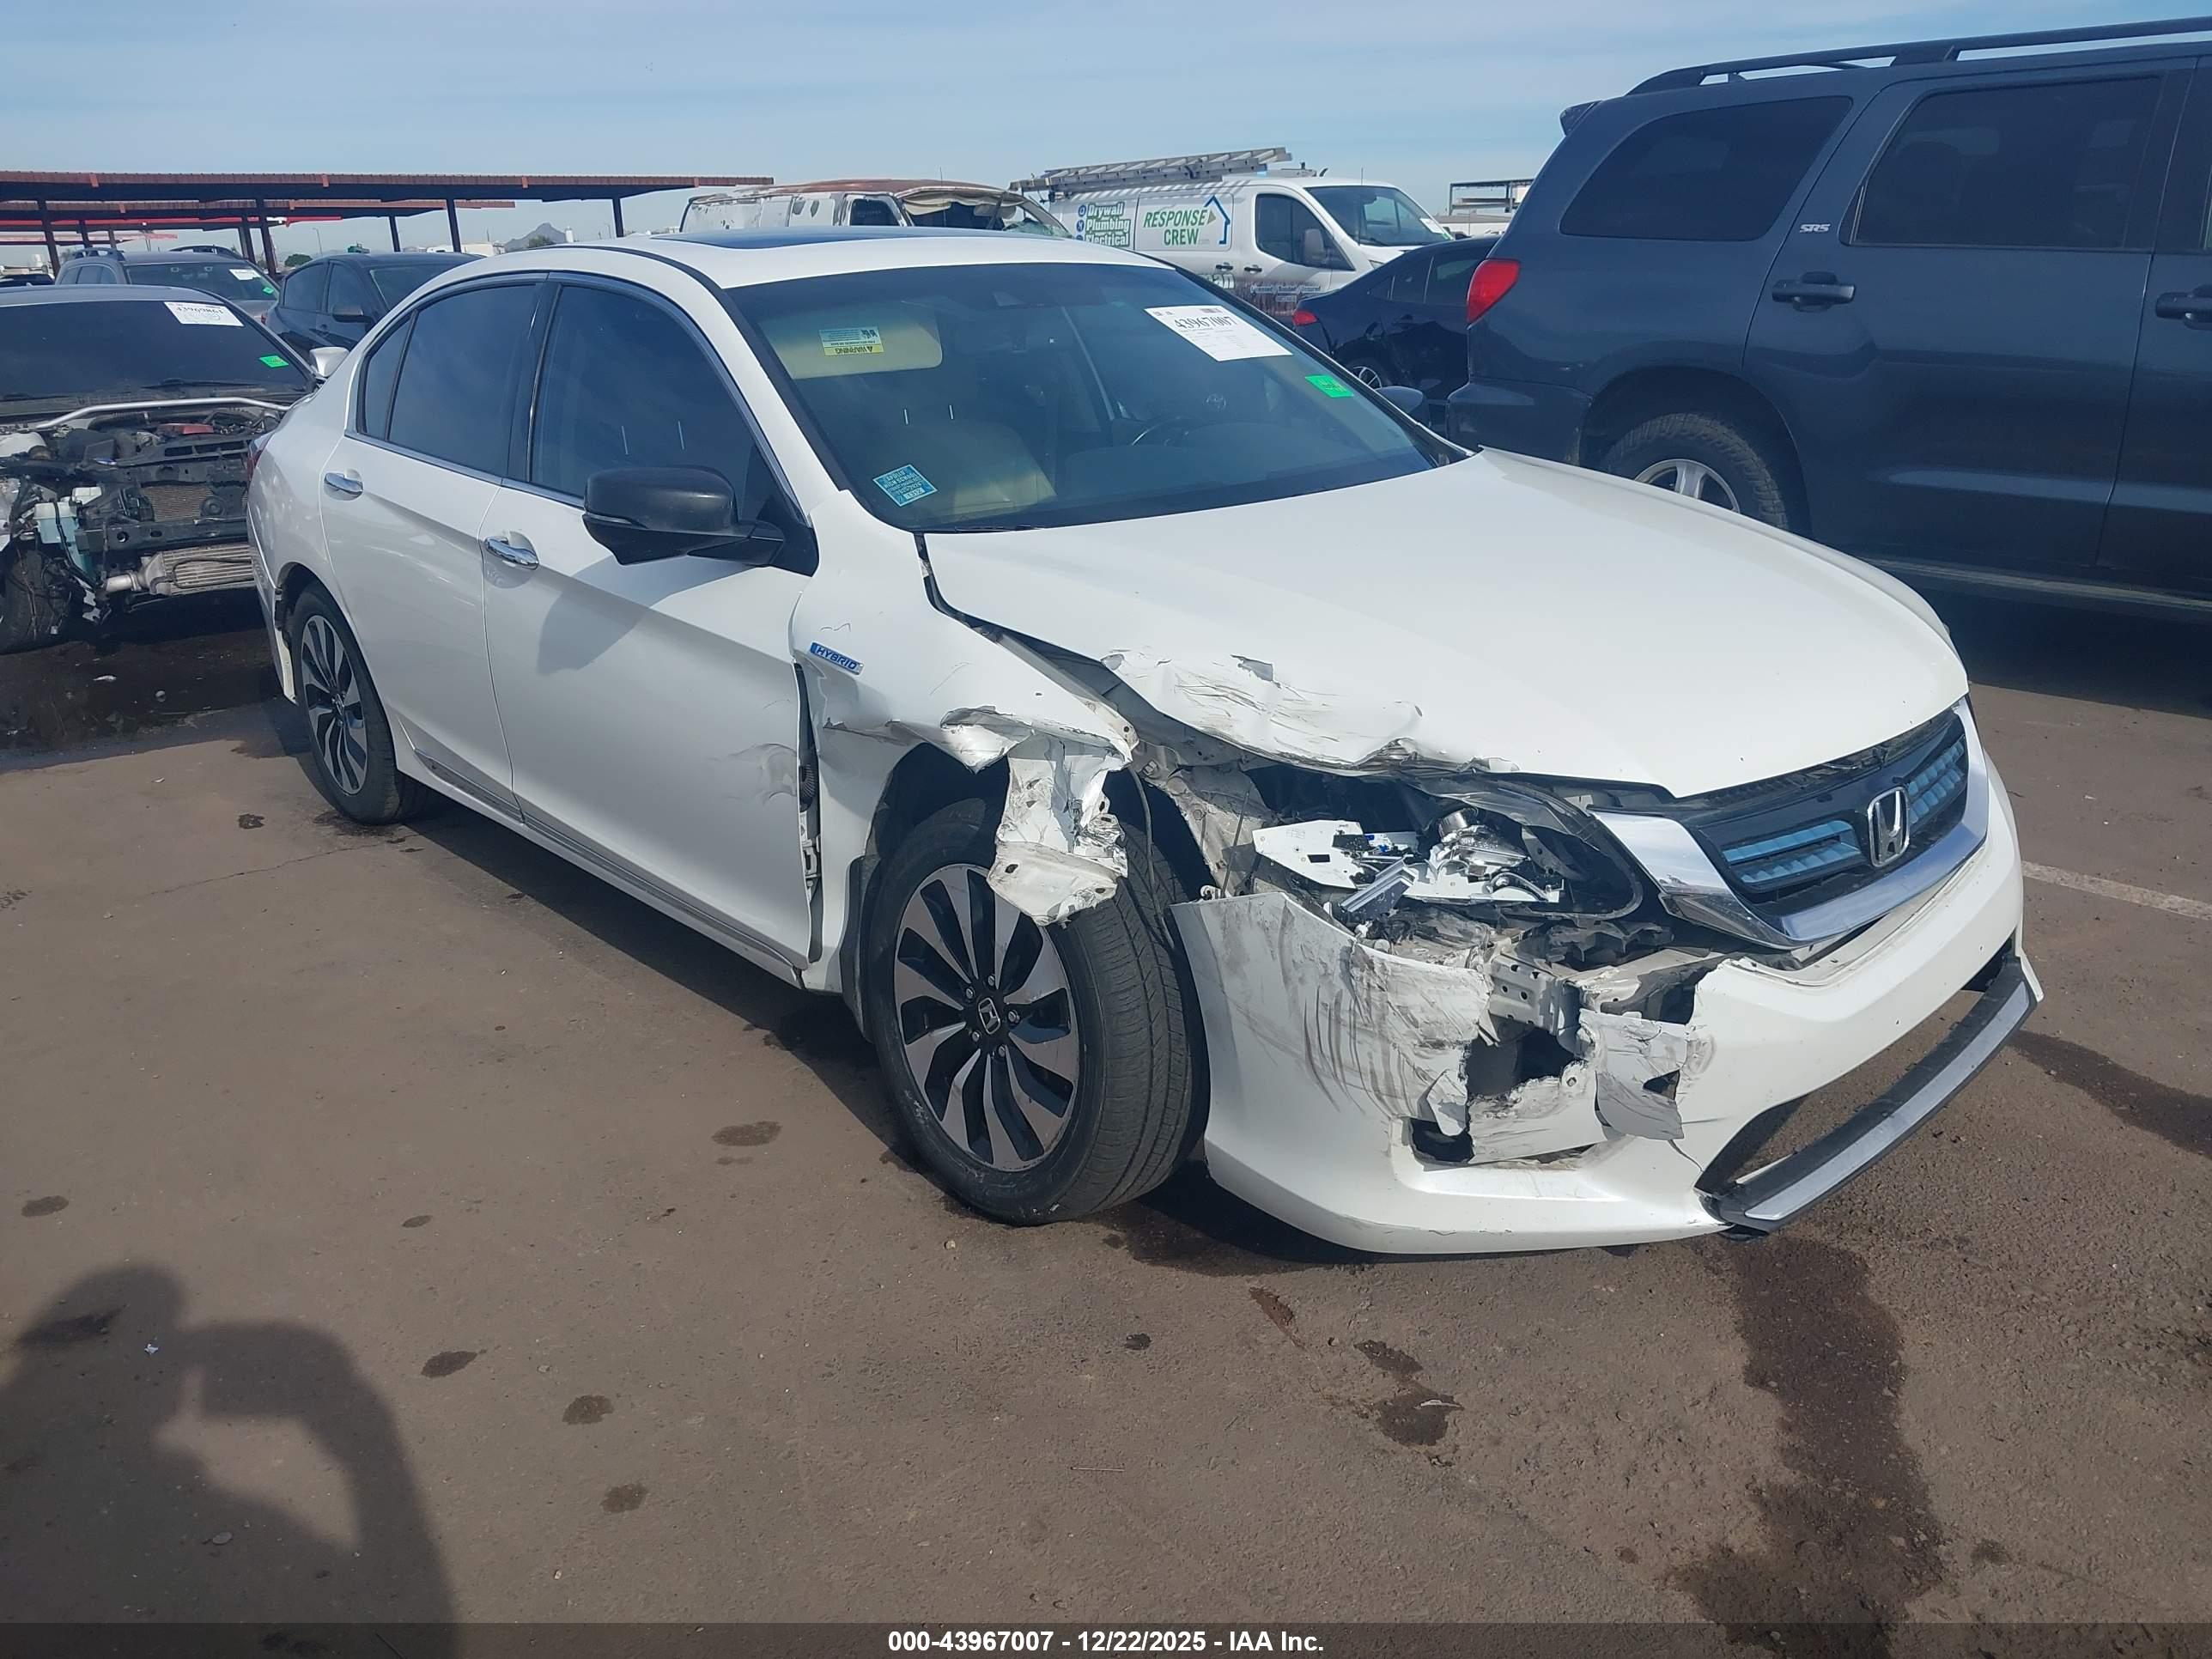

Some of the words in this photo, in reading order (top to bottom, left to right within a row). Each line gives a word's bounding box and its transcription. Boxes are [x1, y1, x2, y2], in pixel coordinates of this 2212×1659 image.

[1087, 202, 1124, 219] Drywall
[1143, 210, 1207, 228] RESPONSE
[1085, 218, 1130, 233] Plumbing
[1164, 228, 1199, 246] CREW
[1174, 316, 1238, 329] 43967007
[817, 647, 857, 670] HYBRID
